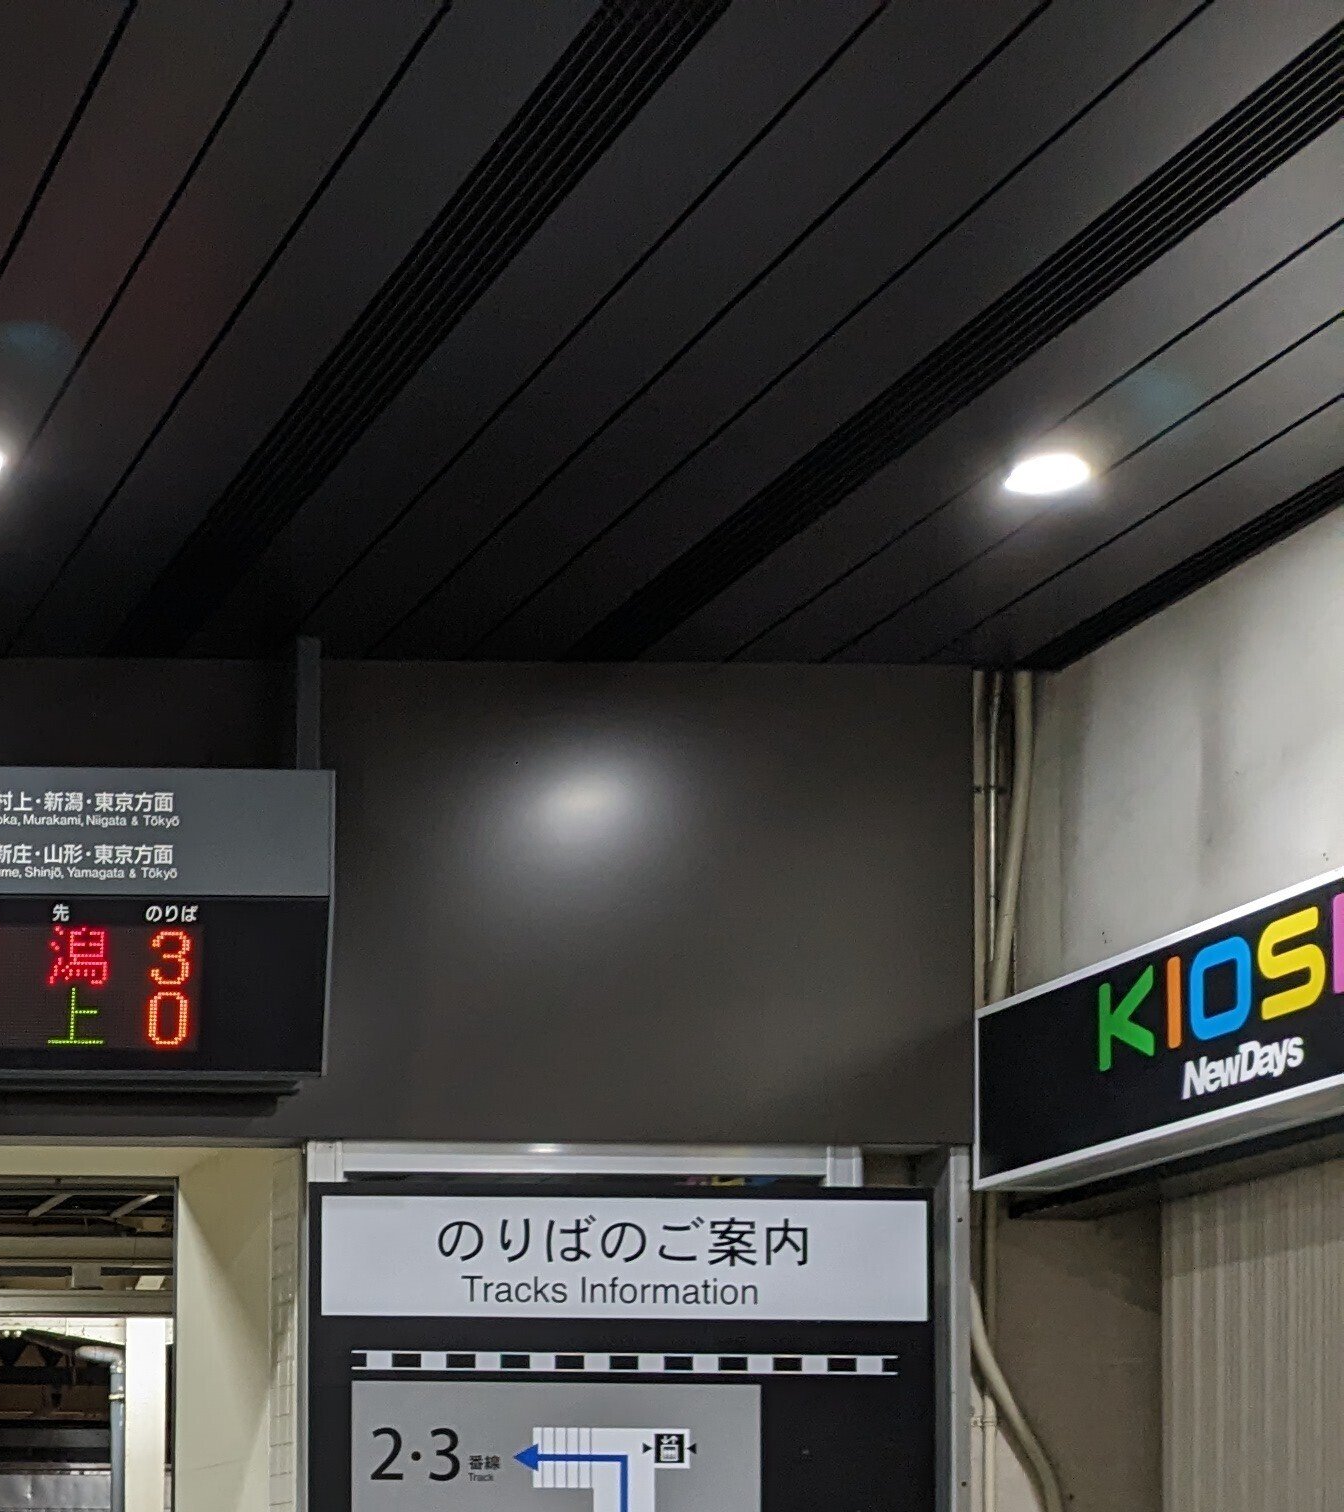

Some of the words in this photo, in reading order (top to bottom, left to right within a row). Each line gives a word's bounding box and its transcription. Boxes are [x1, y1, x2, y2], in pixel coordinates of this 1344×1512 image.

[23, 814, 83, 829] Murakami,
[87, 814, 127, 829] Niigata
[132, 815, 139, 827] &
[66, 867, 123, 882] Yamagata
[128, 867, 137, 879] &
[146, 905, 198, 923] のりば
[151, 930, 192, 986] 3
[1099, 893, 1344, 1072] KIOS
[147, 992, 189, 1048] 0
[1182, 1036, 1304, 1100] NewDays
[438, 1216, 810, 1268] のりばのご案内
[463, 1275, 568, 1304] Tracks
[581, 1277, 759, 1306] Information
[467, 1473, 493, 1483] Track
[469, 1455, 500, 1472] 番線
